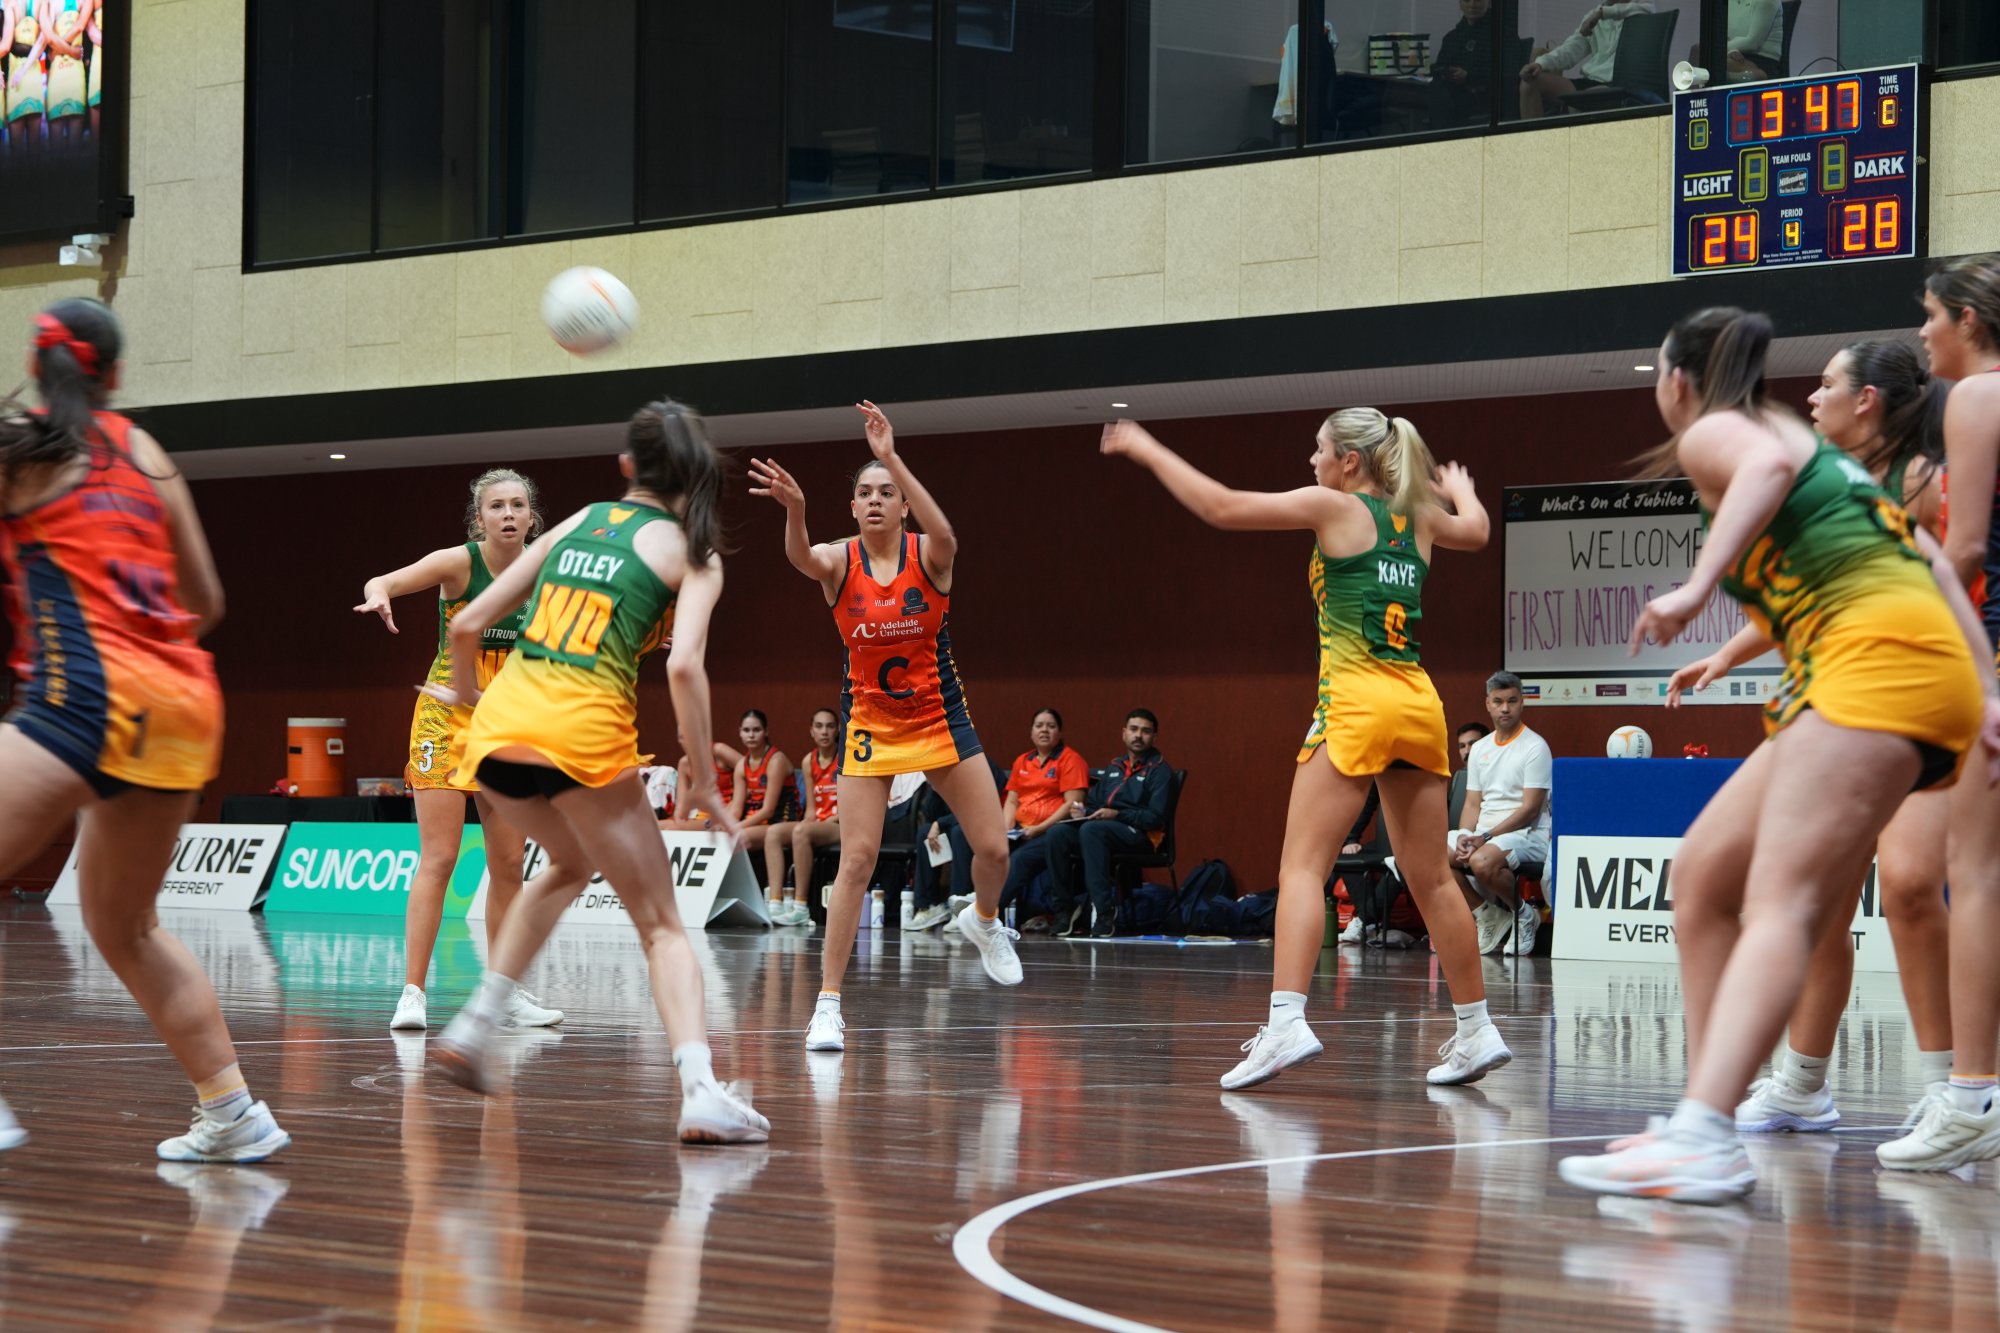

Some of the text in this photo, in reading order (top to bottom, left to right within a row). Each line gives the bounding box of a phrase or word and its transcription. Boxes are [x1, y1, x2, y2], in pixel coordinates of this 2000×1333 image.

[1878, 85, 1899, 95] OUTS
[1879, 75, 1898, 85] TIME
[1689, 108, 1709, 118] OUTS
[1690, 99, 1707, 109] TIME
[1772, 152, 1811, 165] TEAM FOULS
[1854, 156, 1905, 179] DARK
[1683, 175, 1732, 197] LIGHT
[1780, 208, 1803, 218] PERIOD
[1785, 221, 1799, 246] 4
[1843, 201, 1898, 251] 28
[1704, 215, 1757, 264] 24
[1541, 490, 1700, 512] What's On at Jubilee P
[557, 548, 624, 582] OTLEY
[1378, 560, 1416, 587] KAYE
[524, 582, 613, 656] WD
[879, 619, 919, 630] Adelaide
[1508, 590, 1565, 652] FIRST
[482, 628, 518, 640] UTRUW
[880, 626, 925, 638] University
[878, 656, 915, 700] C
[418, 740, 434, 773] 3
[853, 729, 873, 763] 3
[282, 847, 420, 892] SUNCOR
[670, 846, 717, 887] NE
[1574, 856, 1675, 911] MEL
[1608, 923, 1678, 944] EVERY
[1851, 931, 1866, 950] T
